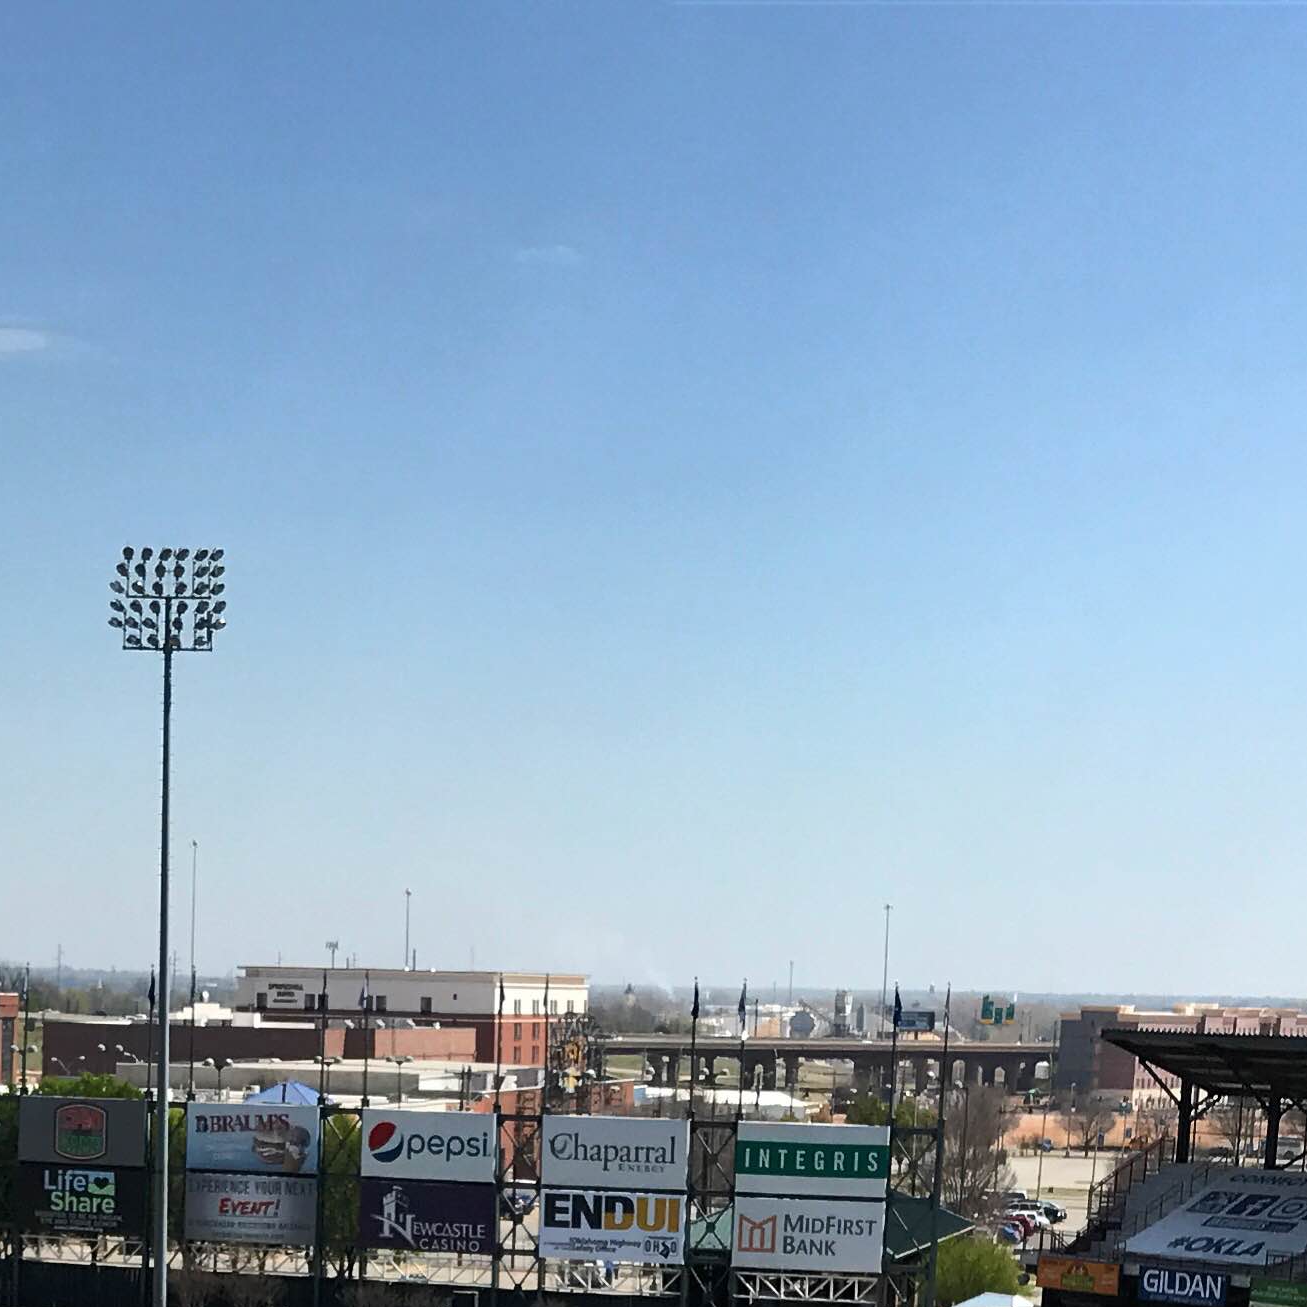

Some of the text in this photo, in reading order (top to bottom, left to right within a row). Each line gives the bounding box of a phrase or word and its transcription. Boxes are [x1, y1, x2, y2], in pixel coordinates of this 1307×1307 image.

[407, 1132, 489, 1162] pepsi
[549, 1133, 676, 1172] Chaparral
[745, 1148, 879, 1172] INTEGRIS
[44, 1169, 87, 1191] Life
[618, 1164, 666, 1173] ENERGY
[50, 1191, 115, 1213] Share
[544, 1193, 681, 1232] ENDUI
[376, 1201, 487, 1244] NEWCASTLE
[419, 1239, 480, 1252] CASINO
[1143, 1269, 1223, 1300] GILDAN
